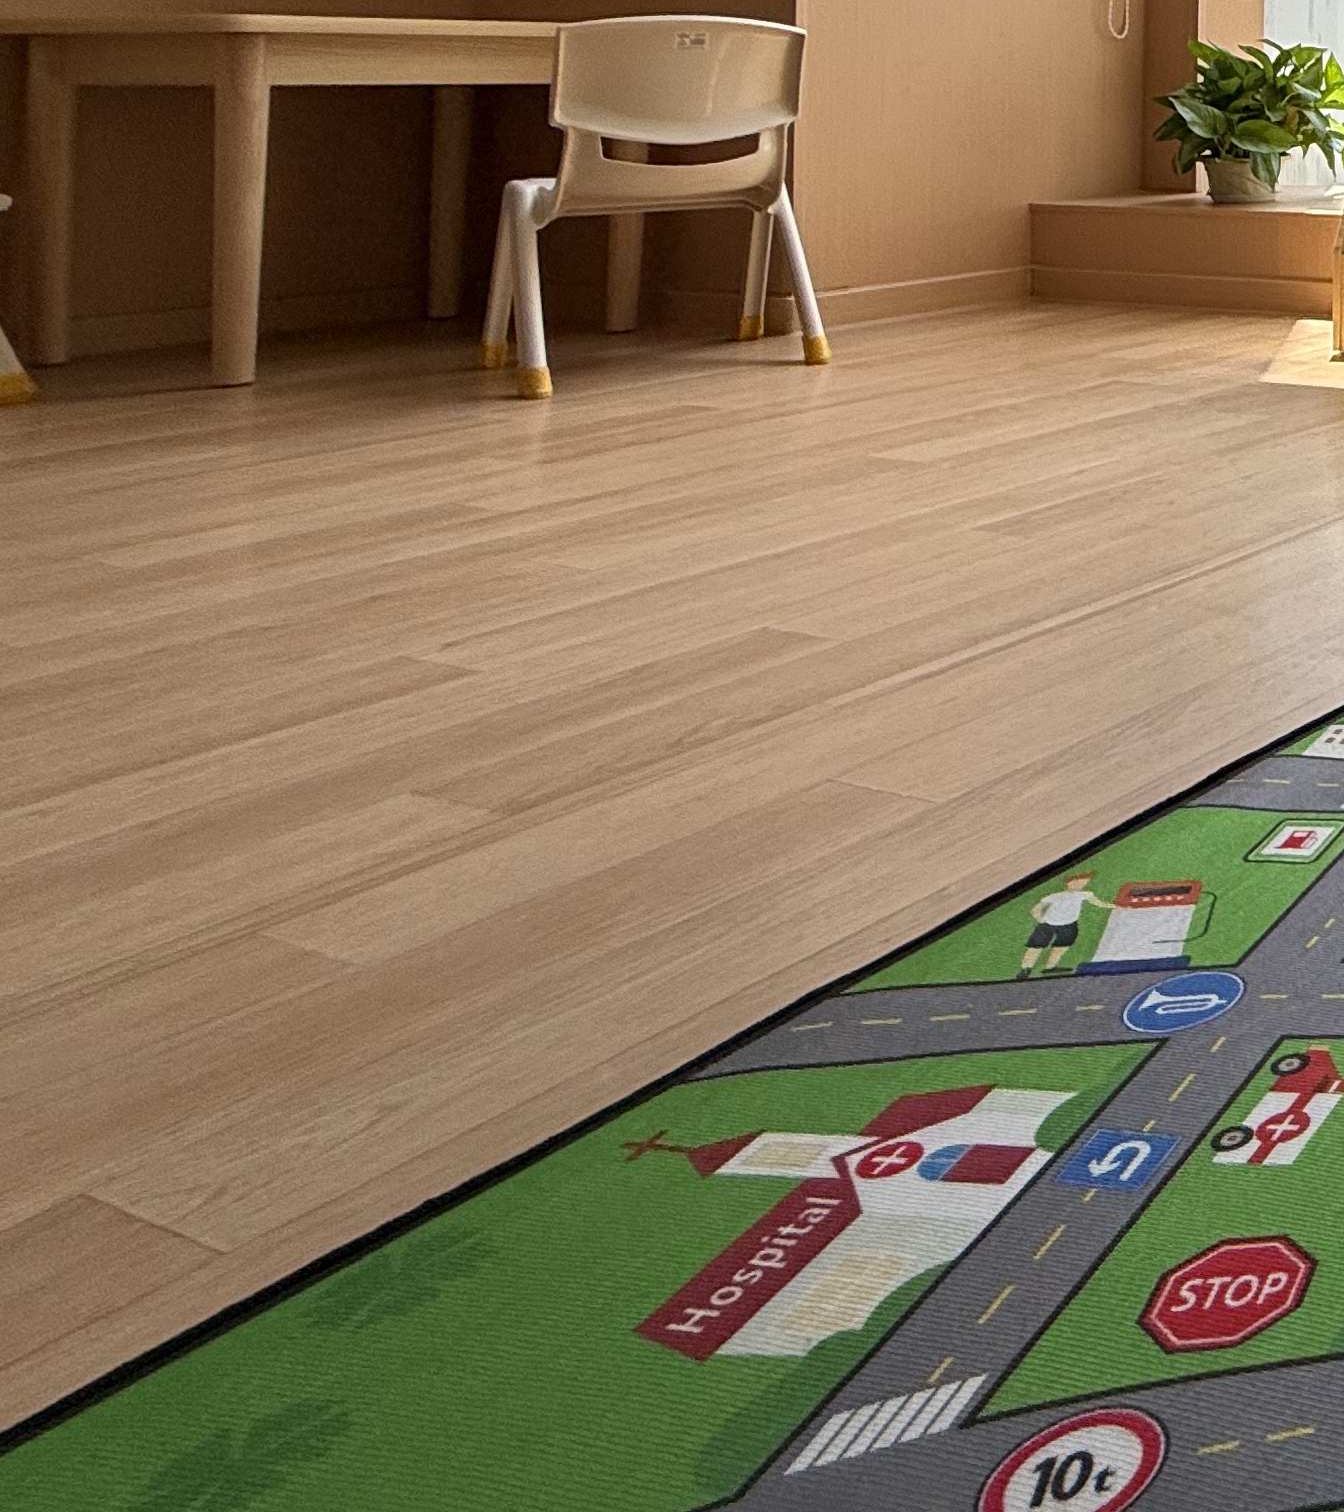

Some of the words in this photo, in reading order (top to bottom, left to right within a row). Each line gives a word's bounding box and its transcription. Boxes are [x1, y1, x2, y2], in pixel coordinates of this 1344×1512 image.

[665, 1194, 842, 1337] Hospital
[1170, 1271, 1289, 1314] STOP
[1028, 1450, 1116, 1511] 10t
